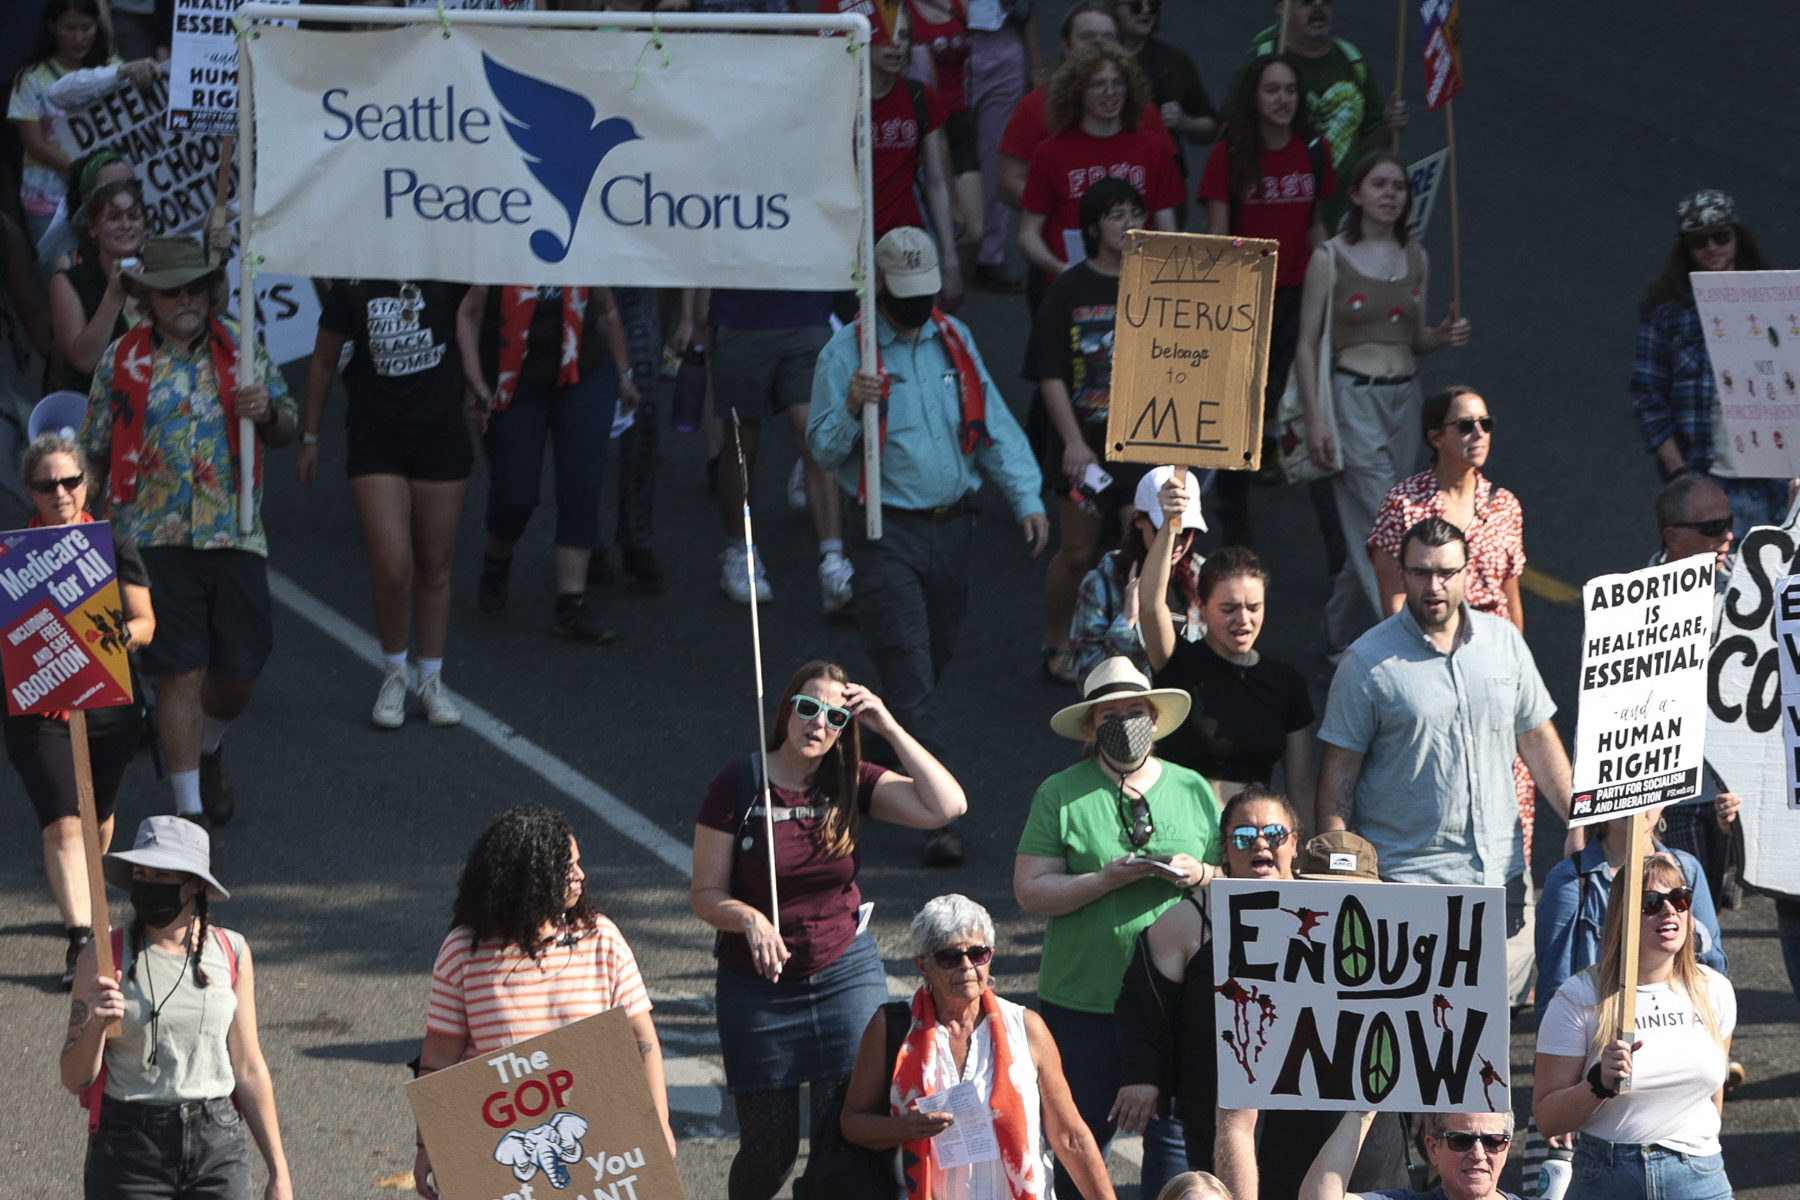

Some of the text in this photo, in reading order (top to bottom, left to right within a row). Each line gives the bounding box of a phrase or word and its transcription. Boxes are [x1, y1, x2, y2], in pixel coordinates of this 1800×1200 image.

[321, 85, 491, 144] Seattle
[383, 167, 791, 231] Peace Chorus
[1155, 244, 1225, 281] MY
[1125, 293, 1255, 332] UTERUS
[1151, 338, 1210, 367] belongs
[1165, 367, 1187, 384] to
[1129, 396, 1222, 444] ME
[0, 528, 91, 602] Medicare
[46, 547, 114, 610] for All
[1590, 563, 1714, 612] ABORTION
[6, 607, 55, 647] INCLUDING
[39, 618, 66, 643] FREE
[1644, 604, 1661, 626] IS
[31, 630, 76, 668] AND SAFE
[1587, 614, 1708, 659] HEALTHCARE,
[11, 644, 91, 712] ABORTION
[1582, 643, 1705, 691] ESSENTIAL,
[1597, 716, 1683, 754] HUMAN
[1597, 744, 1682, 785] RIGHT!
[1593, 790, 1663, 814] AND LIBERATION
[1595, 771, 1687, 801] PARTY FOR SOCIALISM
[1573, 800, 1592, 816] PSL
[488, 1050, 550, 1084] The
[1270, 1007, 1489, 1106] NOW
[482, 1069, 574, 1129] GOP
[586, 1147, 647, 1182] You
